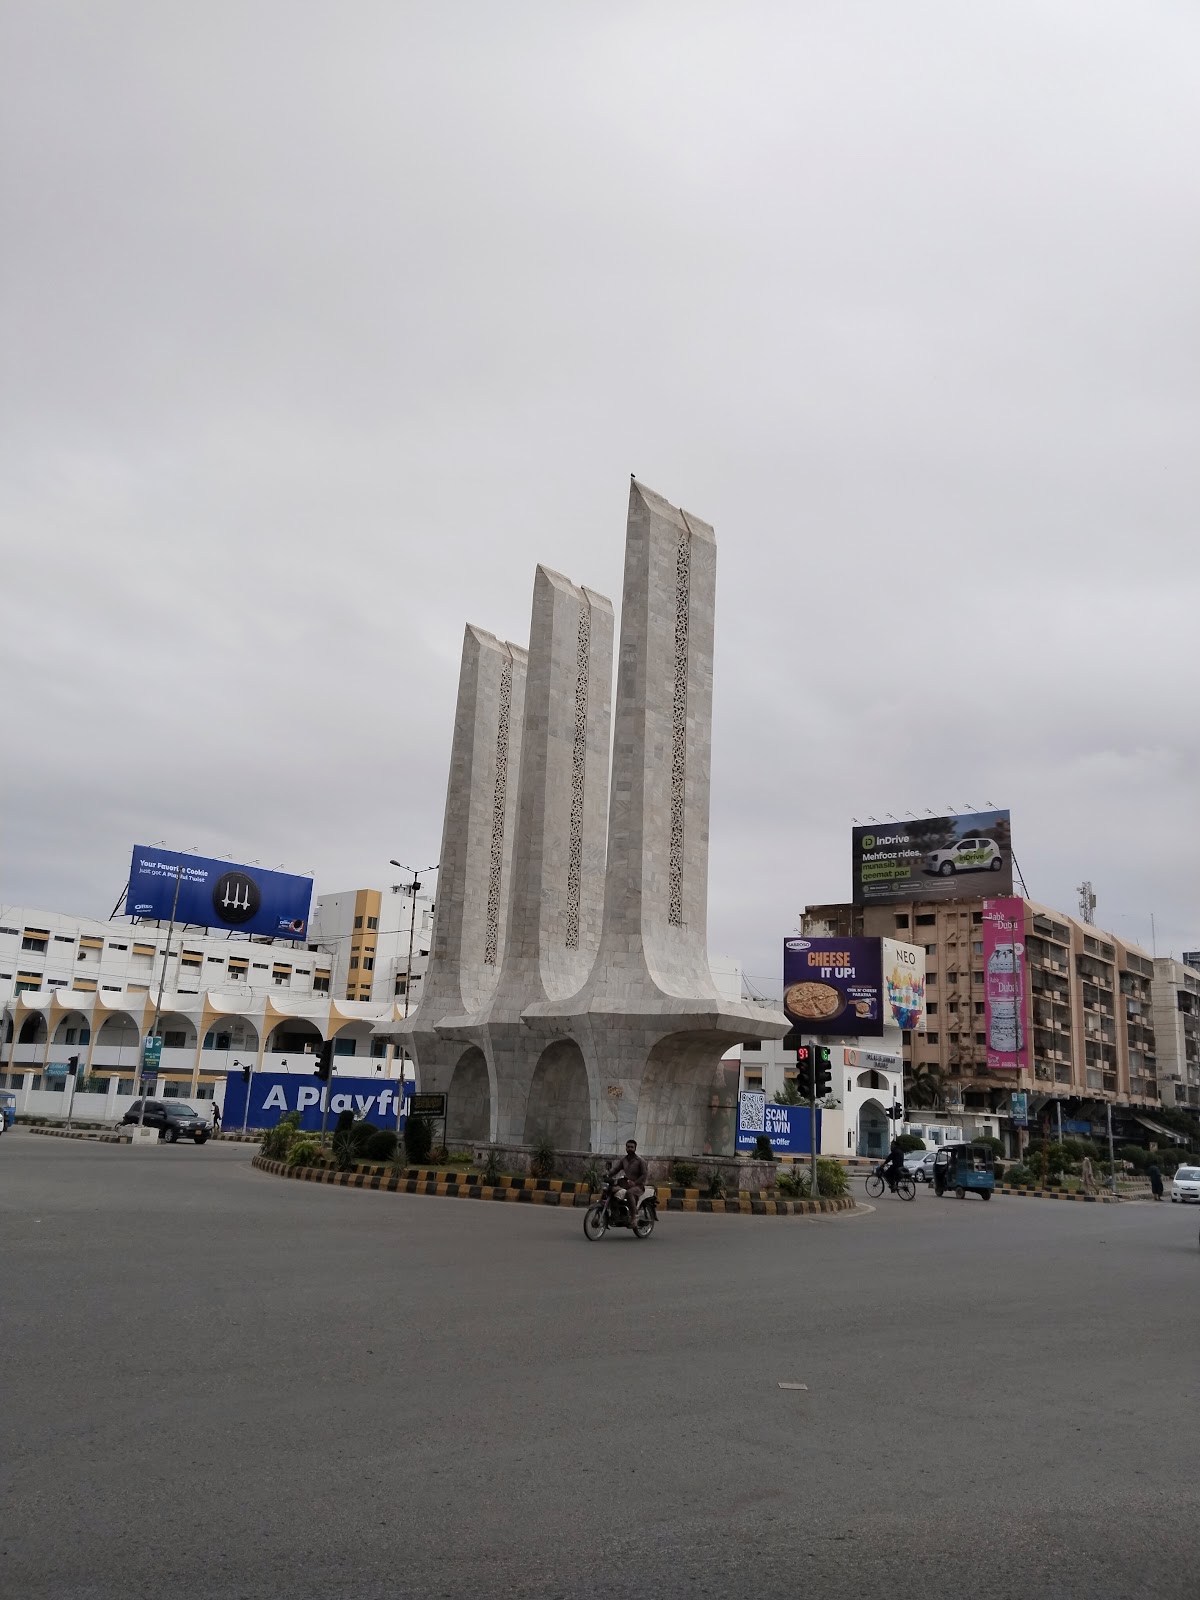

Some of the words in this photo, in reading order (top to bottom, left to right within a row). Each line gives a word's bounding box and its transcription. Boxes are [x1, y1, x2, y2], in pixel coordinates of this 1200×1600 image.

[876, 835, 910, 846] inDrive
[862, 851, 897, 861] Mehfooz
[960, 853, 984, 861] inDrive
[140, 859, 156, 868] Your
[157, 862, 186, 873] Favorie
[186, 867, 209, 877] Cookie
[862, 861, 895, 870] munasib
[862, 871, 894, 880] qeemat
[894, 870, 909, 878] par
[807, 951, 851, 967] CHEESE
[895, 949, 916, 965] NEO
[820, 967, 832, 979] IT
[834, 967, 856, 979] UP!
[261, 1084, 288, 1111] A
[765, 1108, 788, 1122] SCAN
[765, 1120, 773, 1133] &
[773, 1121, 791, 1134] WIN
[776, 1138, 791, 1146] Offer
